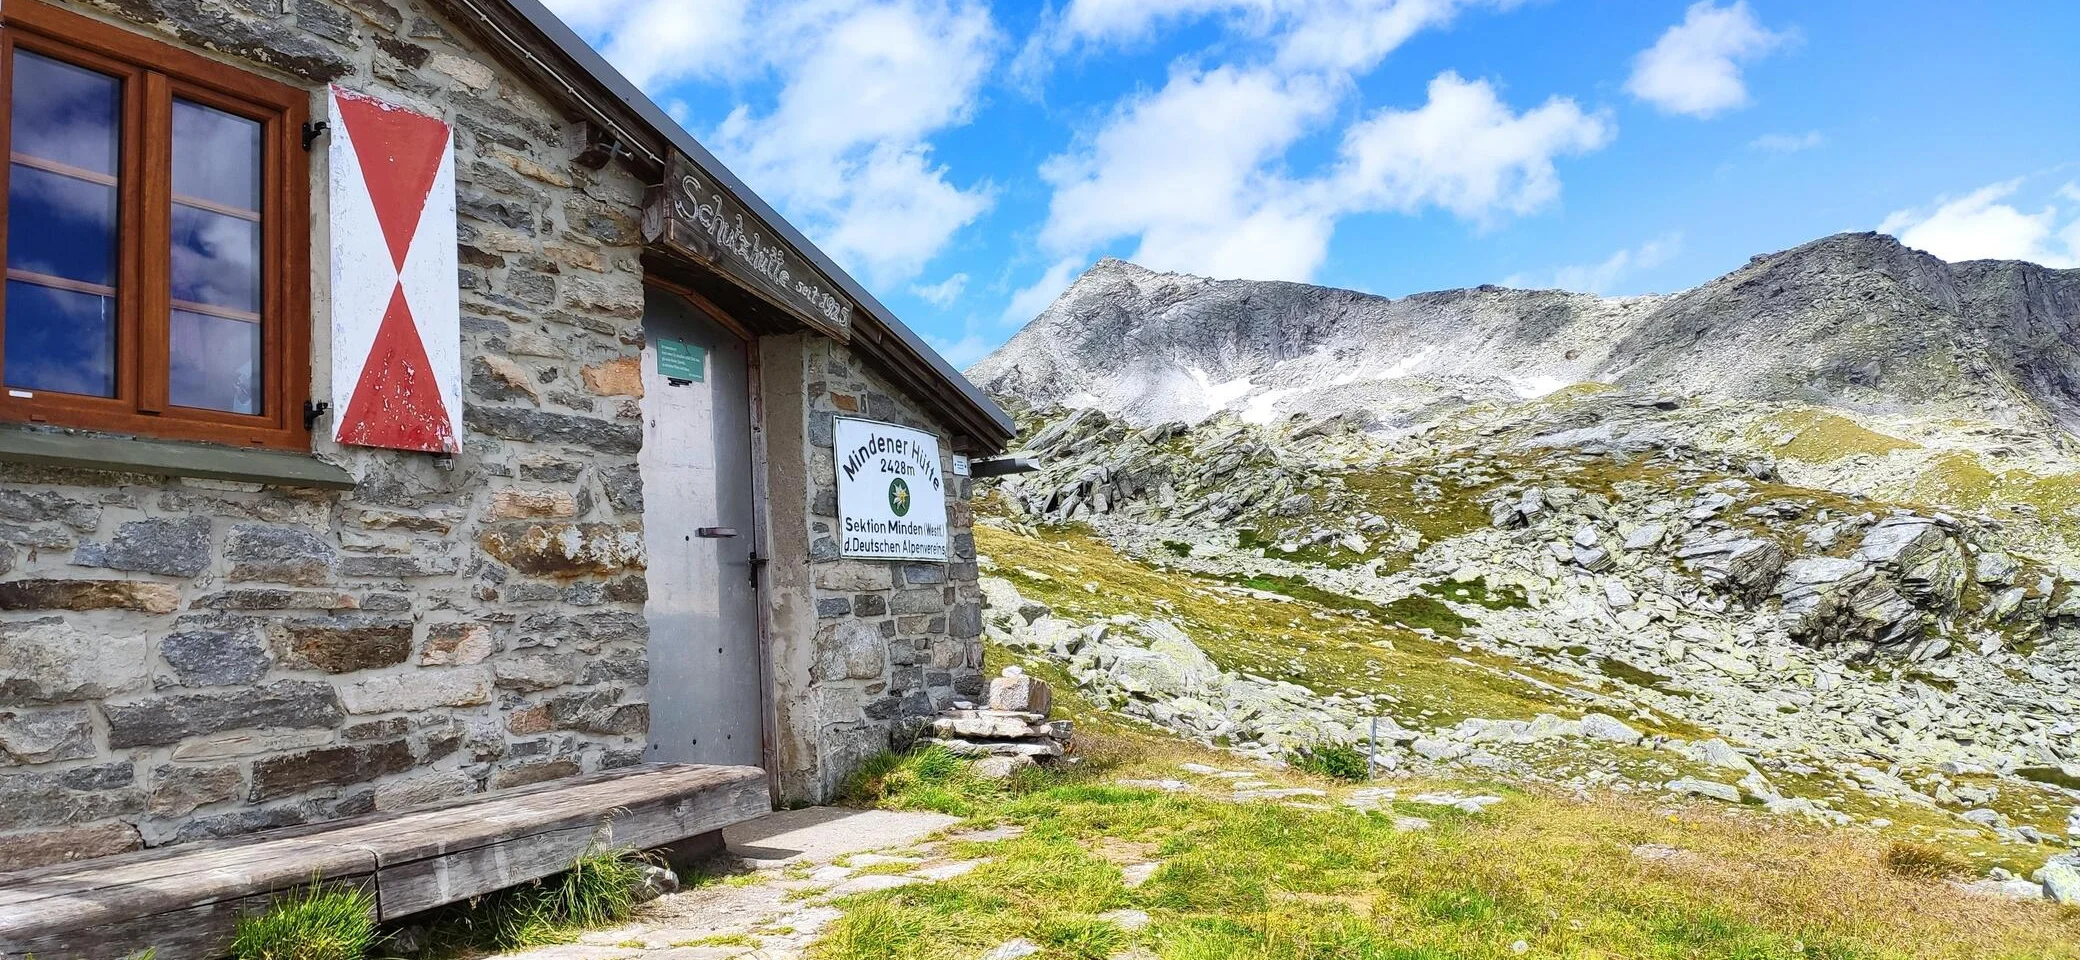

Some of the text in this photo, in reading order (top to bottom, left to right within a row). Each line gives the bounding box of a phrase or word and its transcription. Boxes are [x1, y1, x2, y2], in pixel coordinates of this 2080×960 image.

[674, 175, 849, 327] Schutzhütte seit 1925
[843, 433, 940, 491] Mindener Hütte
[880, 459, 915, 476] 2428m
[845, 517, 886, 534] Sektion
[888, 519, 923, 535] Minden
[903, 540, 945, 556] Alpenvereins
